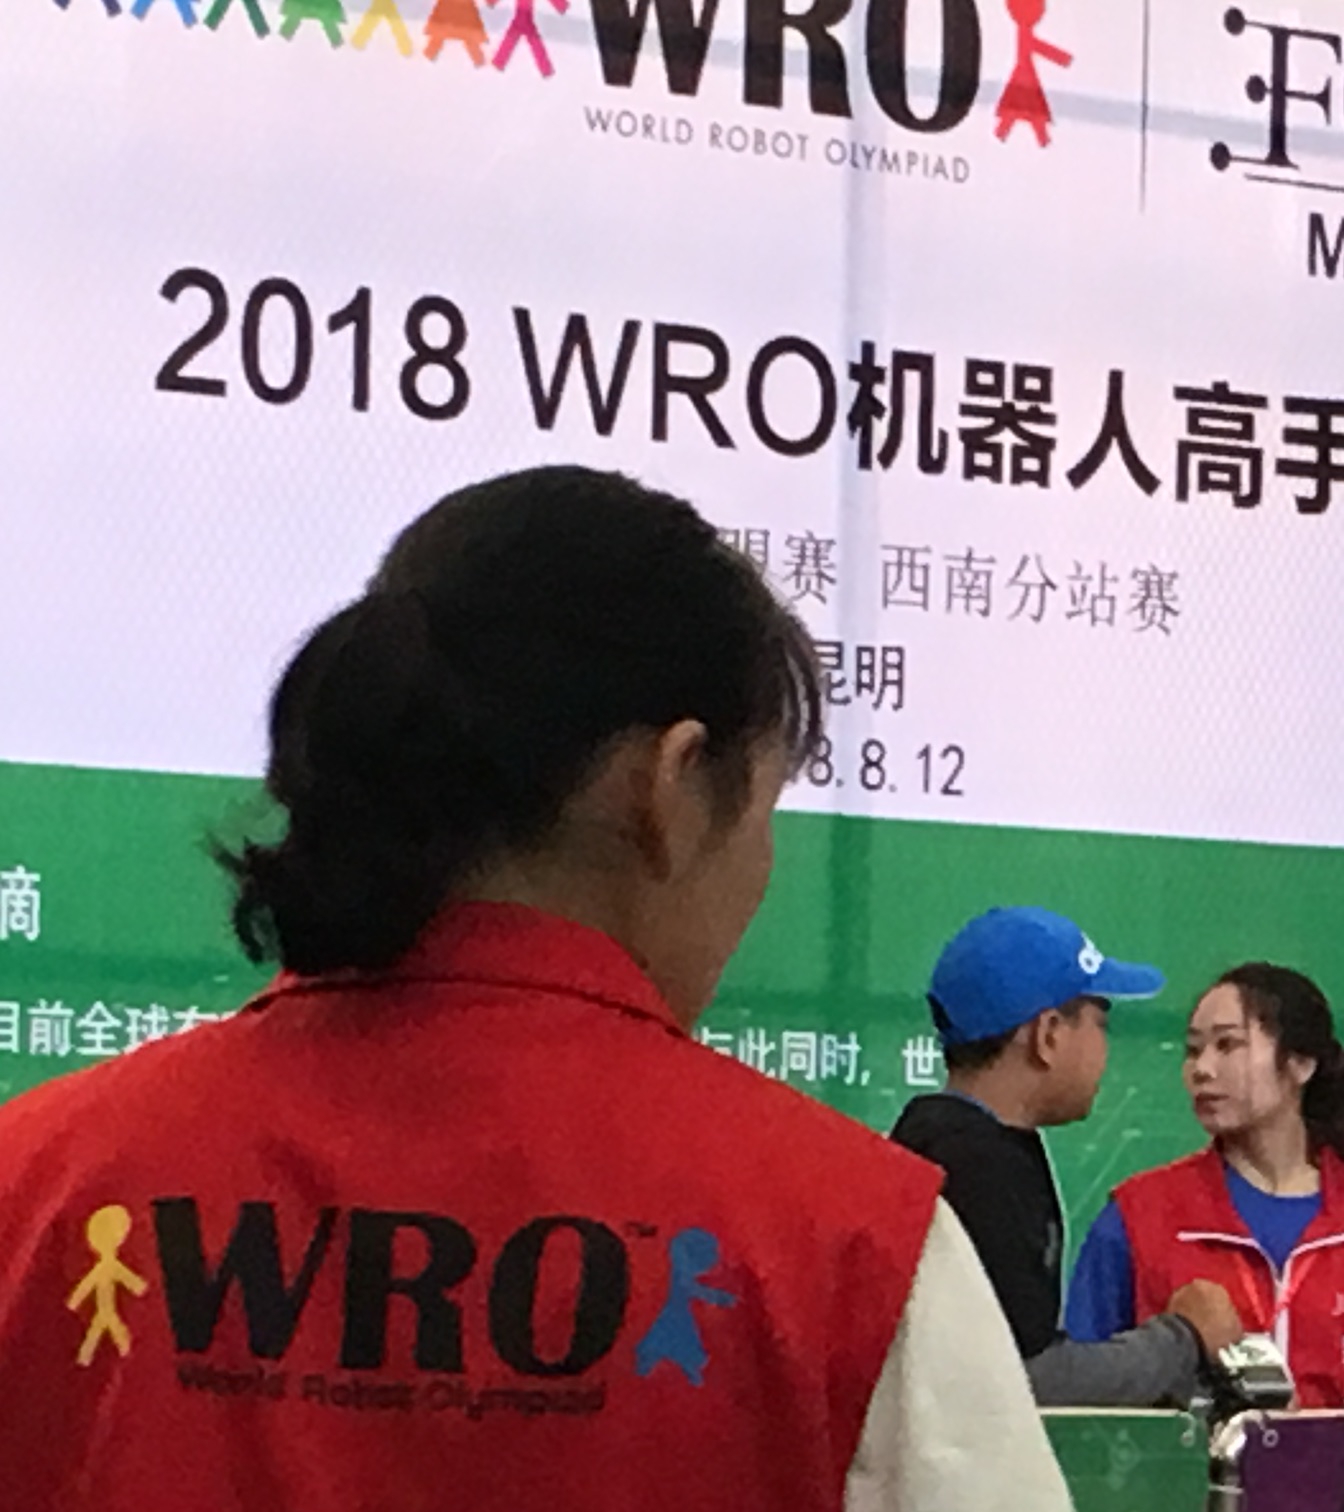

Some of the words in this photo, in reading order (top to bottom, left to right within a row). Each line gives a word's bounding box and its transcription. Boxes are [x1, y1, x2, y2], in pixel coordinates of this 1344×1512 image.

[584, 106, 694, 146] WORLD
[709, 132, 809, 163] ROBOT
[825, 138, 970, 185] OLYMPIAD
[154, 266, 471, 422] 2018
[880, 542, 1182, 636] 西南分站赛
[803, 736, 967, 796] 8.8.12
[150, 1196, 632, 1376] WRO
